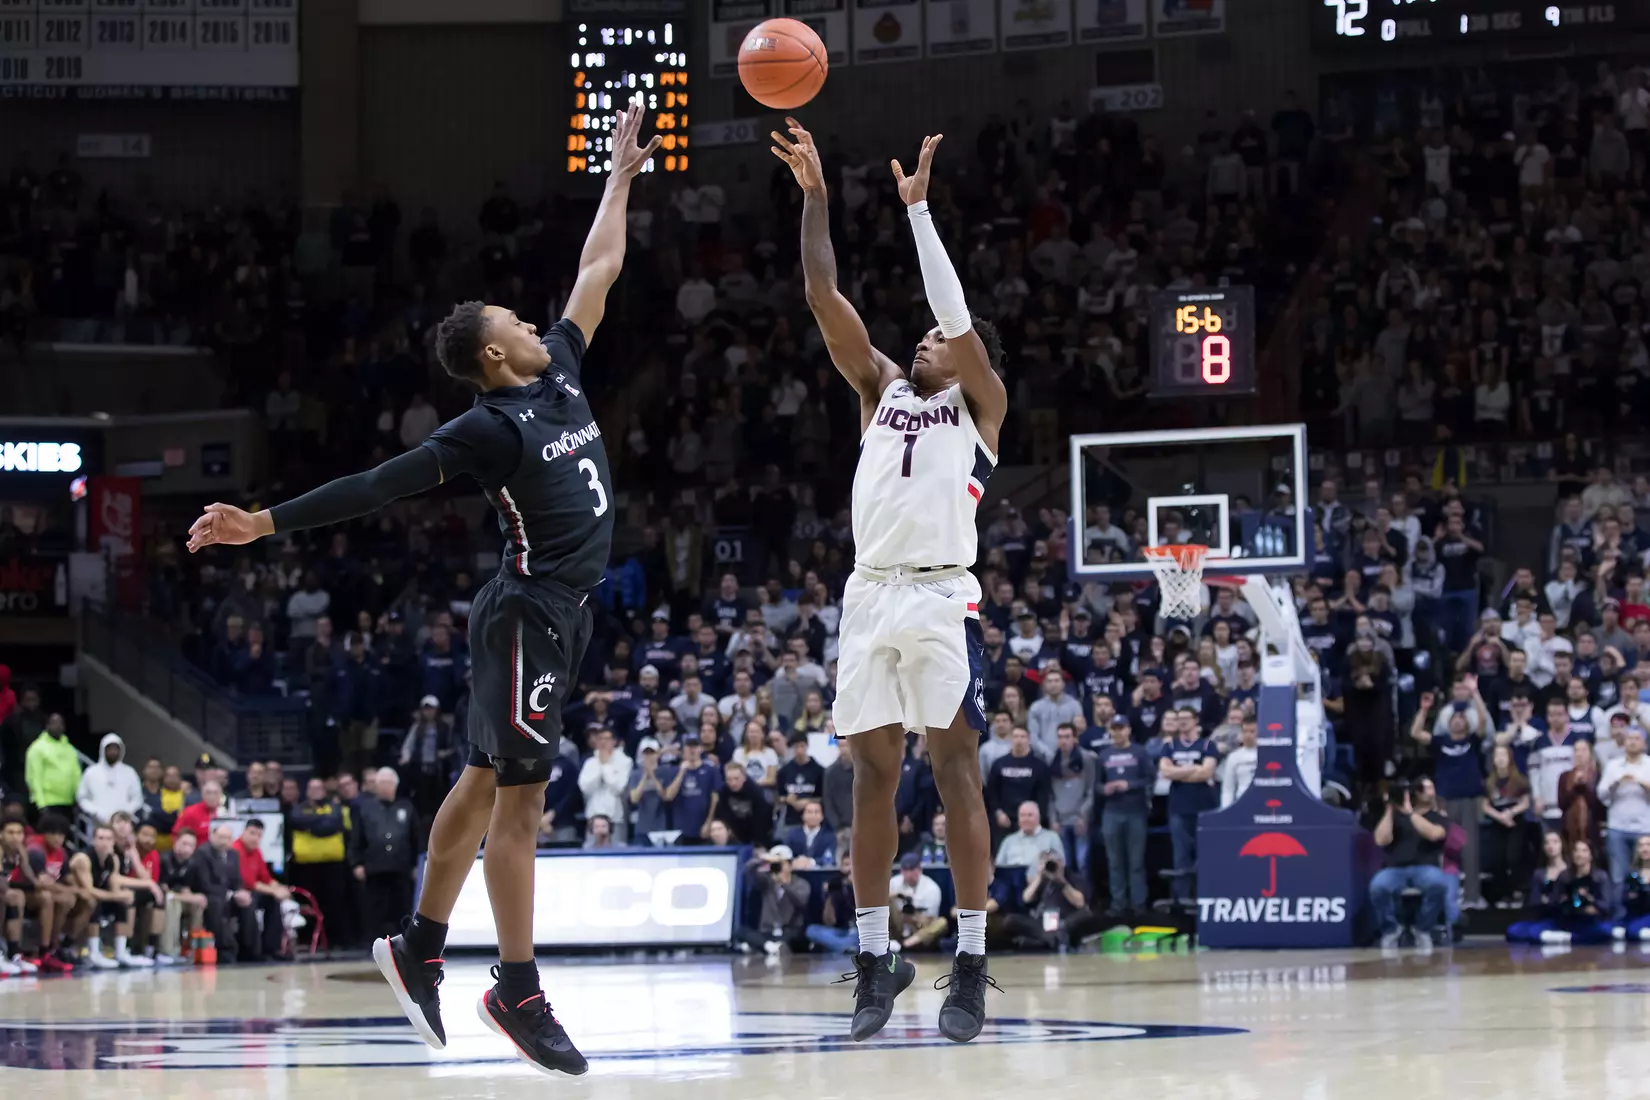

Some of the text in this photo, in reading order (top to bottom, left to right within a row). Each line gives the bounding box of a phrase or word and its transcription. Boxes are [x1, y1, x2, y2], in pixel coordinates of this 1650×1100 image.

[1381, 19, 1396, 41] 0
[1545, 6, 1560, 27] 9
[45, 20, 81, 42] 2012
[98, 20, 135, 43] 2013
[149, 20, 187, 43] 2014
[202, 20, 239, 44] 2015
[253, 20, 290, 44] 2016
[1202, 335, 1230, 384] 8
[876, 405, 960, 432] UCONN
[0, 442, 82, 472] KIES
[901, 433, 918, 478] 1
[578, 457, 608, 517] 3
[1197, 897, 1347, 922] TRAVELERS
